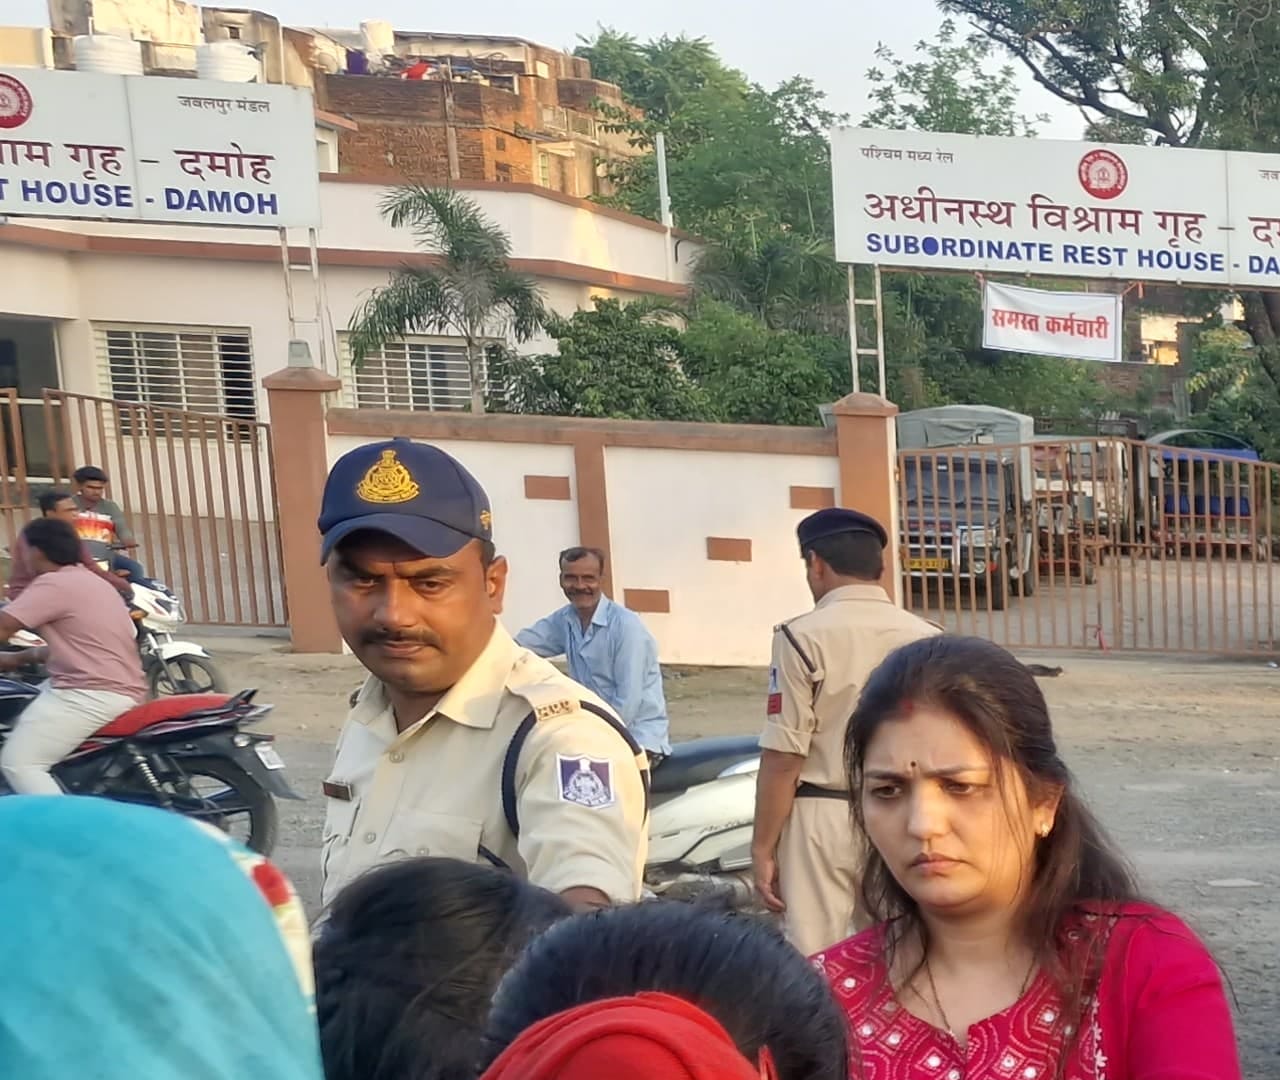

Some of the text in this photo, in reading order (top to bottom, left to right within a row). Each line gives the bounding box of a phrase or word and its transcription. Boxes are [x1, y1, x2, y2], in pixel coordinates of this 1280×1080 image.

[63, 143, 125, 181] गृह
[173, 142, 276, 185] दमोह
[907, 149, 932, 163] मध्य
[936, 148, 954, 163] रेल
[21, 179, 134, 208] HOUSE
[164, 188, 278, 216] DAMOH
[864, 186, 1016, 229] अधीनस्थ
[1027, 194, 1143, 235] विश्राम
[1153, 210, 1207, 248] गृह
[866, 233, 1053, 263] SUBORDINATE
[1063, 244, 1128, 266] REST
[1137, 248, 1225, 272] HOUSE
[992, 309, 1110, 339] समस्त कर्मचारी
